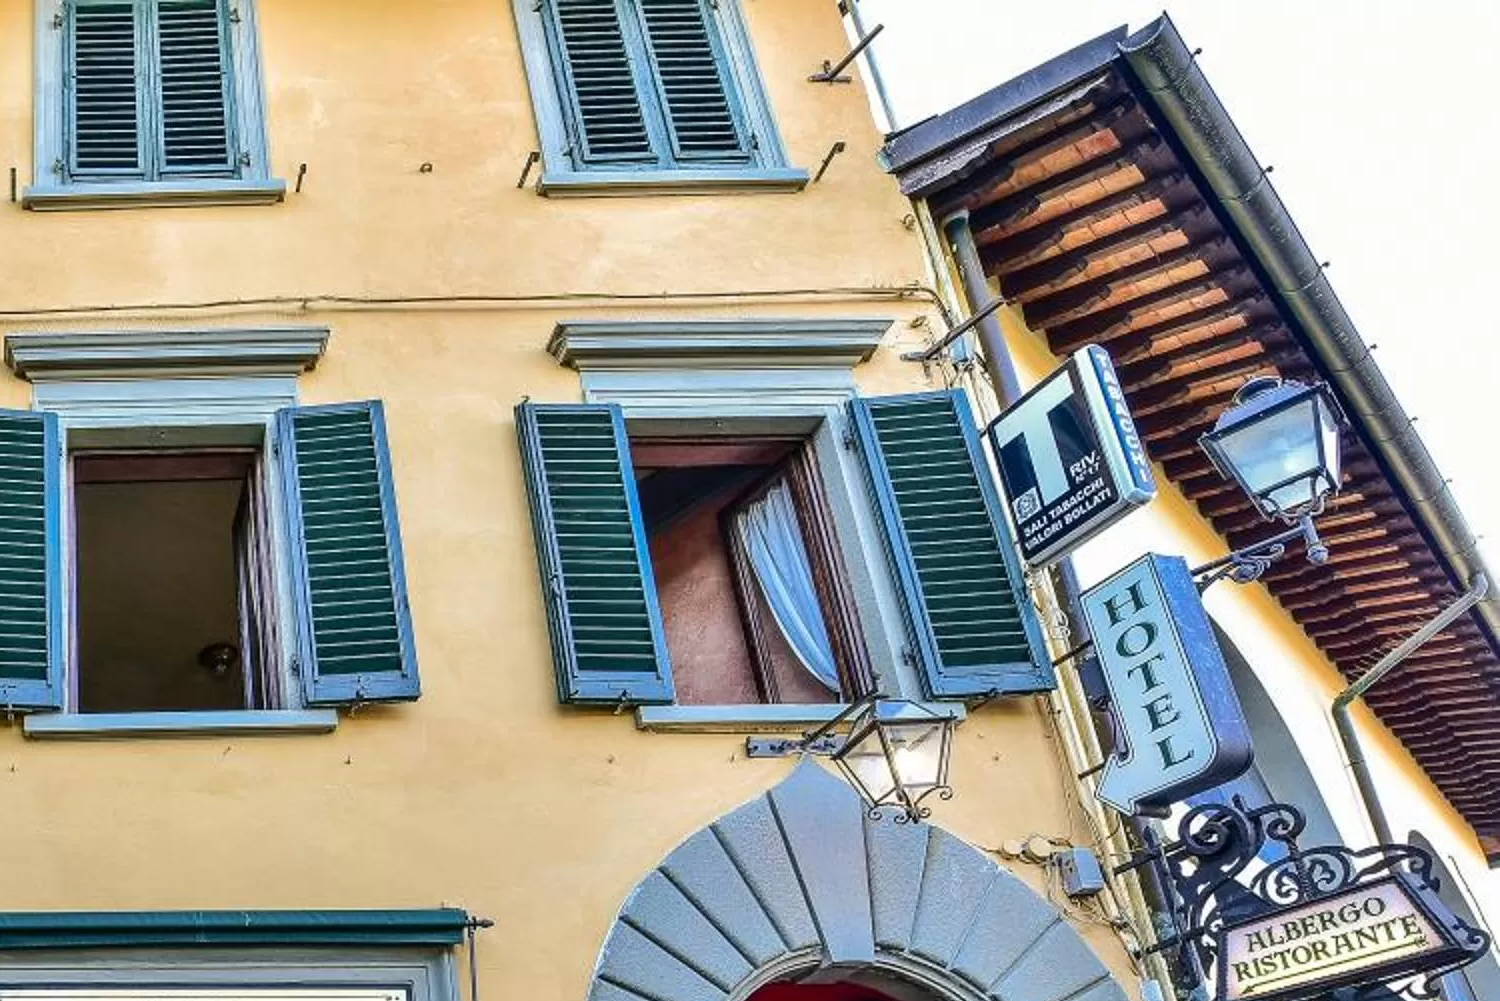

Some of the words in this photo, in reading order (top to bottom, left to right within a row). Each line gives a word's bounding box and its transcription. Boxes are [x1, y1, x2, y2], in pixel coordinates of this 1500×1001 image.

[1024, 514, 1049, 537] SALI
[1051, 477, 1105, 519] TABACCHI
[1025, 519, 1063, 550] VALORI
[1065, 487, 1112, 525] BOLLATI
[1103, 580, 1194, 771] HOTEL
[1231, 914, 1423, 983] RISTORANTE
[1246, 897, 1386, 953] ALBERGO
